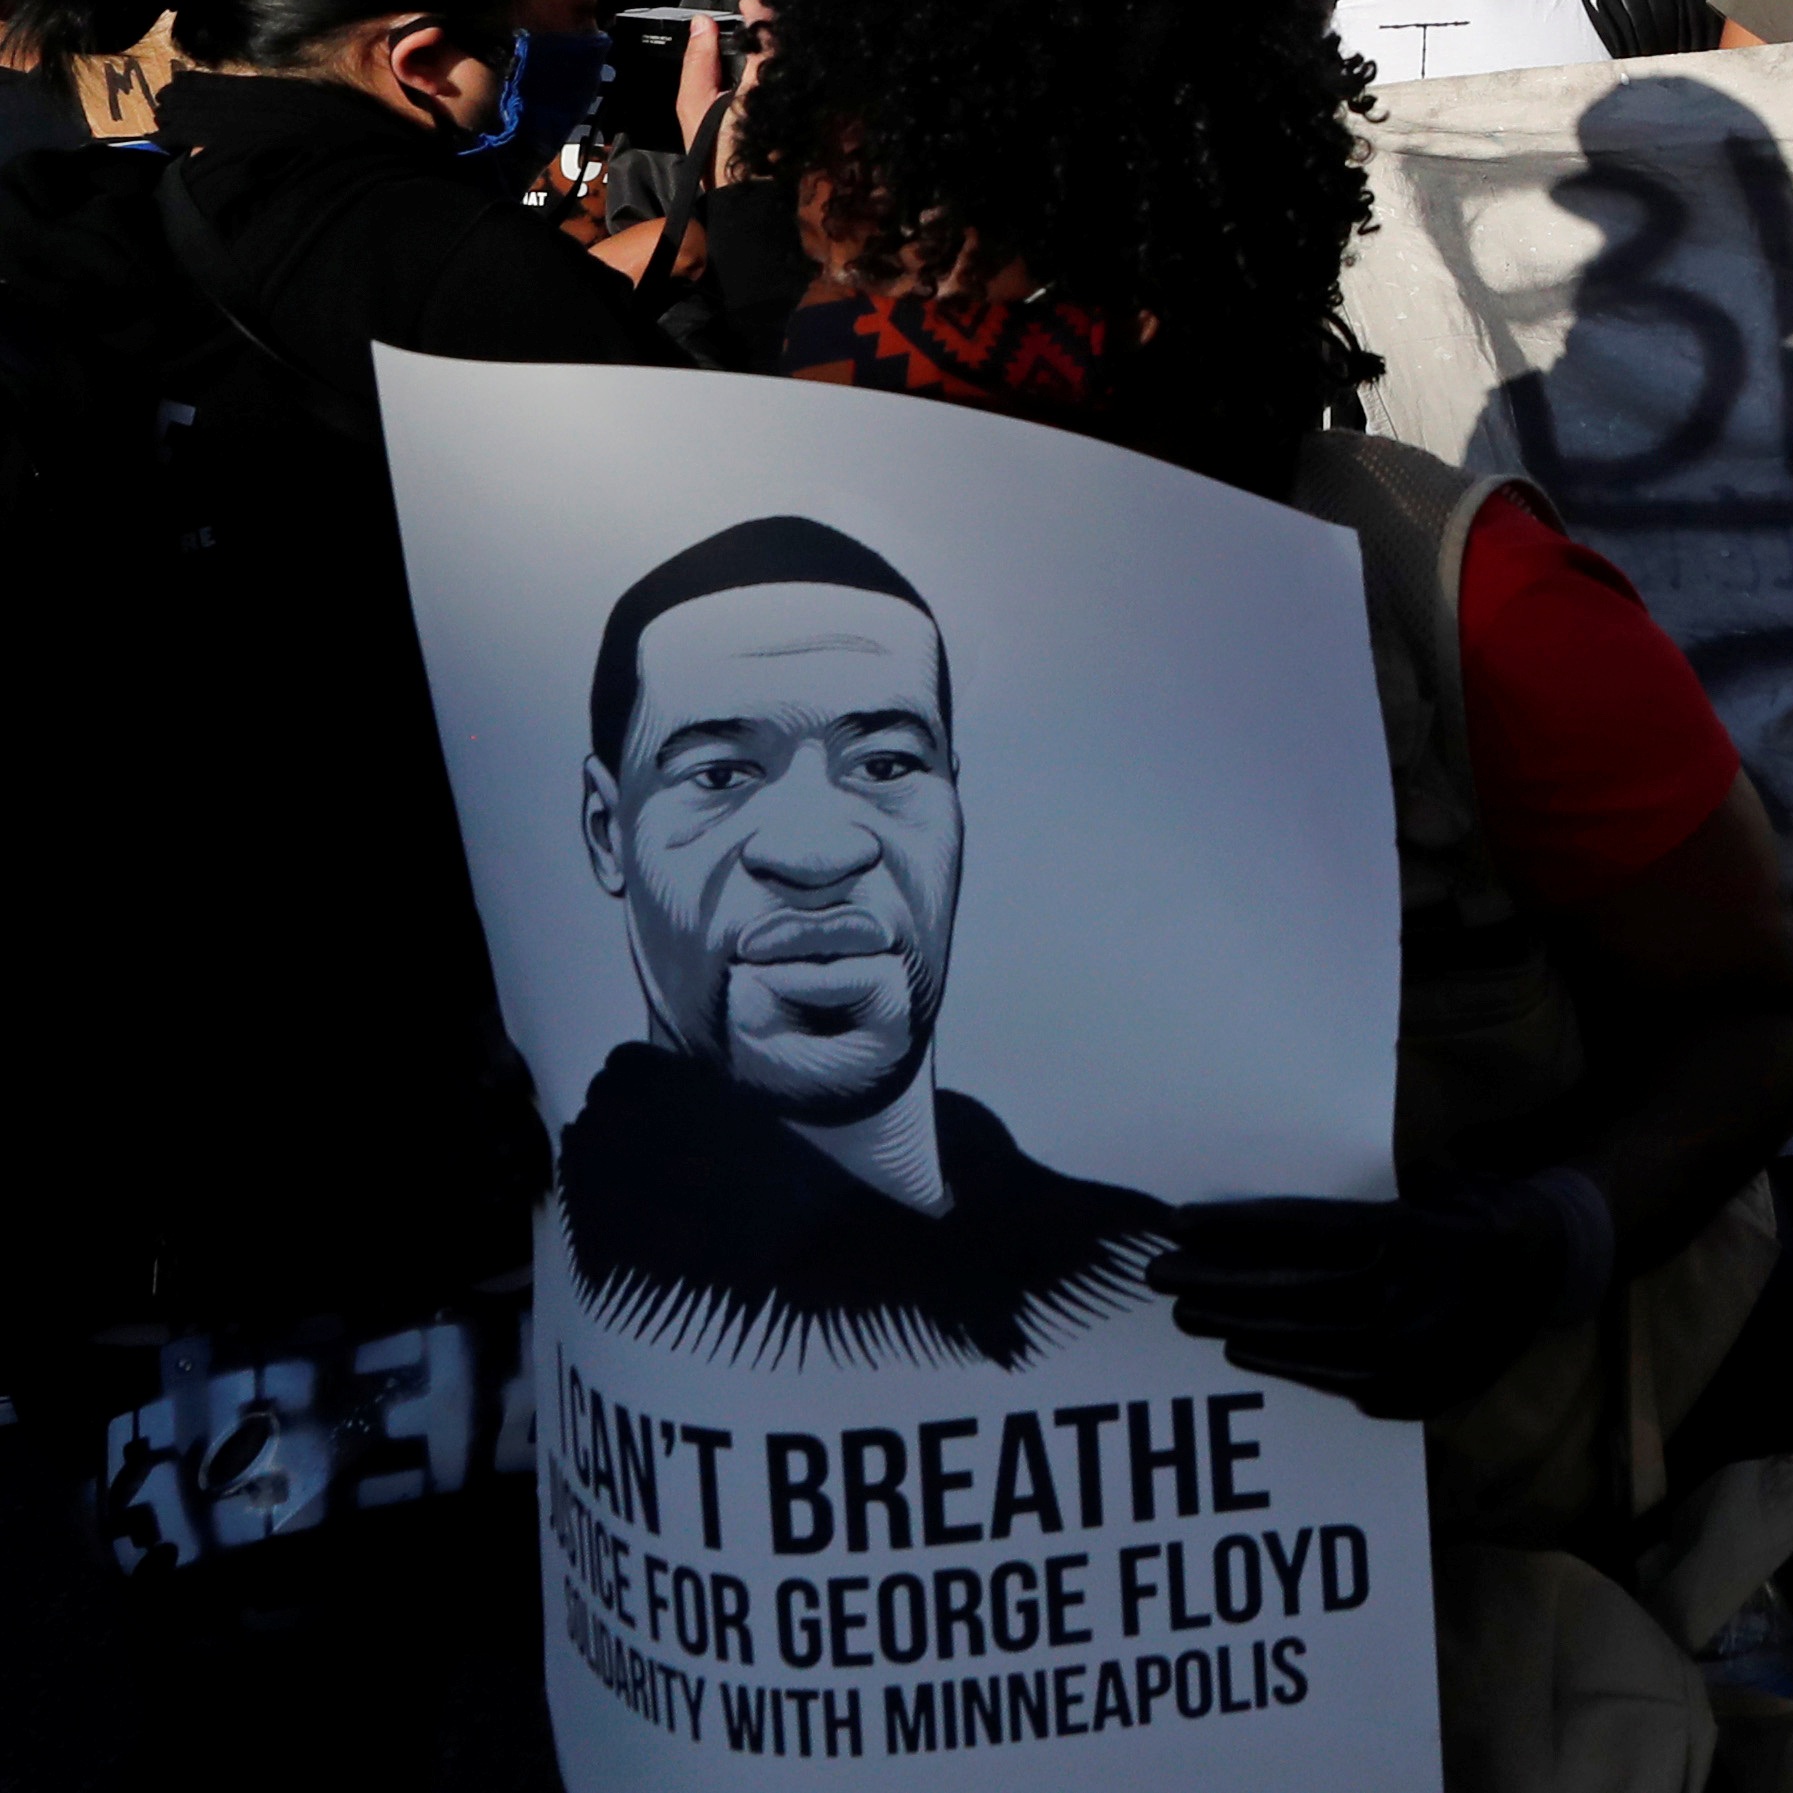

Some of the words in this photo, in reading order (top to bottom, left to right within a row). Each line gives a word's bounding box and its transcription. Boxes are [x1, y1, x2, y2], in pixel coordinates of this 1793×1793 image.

[555, 1341, 565, 1452] I
[573, 1369, 734, 1551] CAN'T
[764, 1390, 1271, 1558] BREATHE
[547, 1452, 634, 1630] JUSTICE
[644, 1549, 755, 1667] FOR
[774, 1551, 1093, 1670] GEORGE
[1117, 1523, 1372, 1640] FLOYD
[563, 1574, 706, 1744] SOLIDARITY
[719, 1679, 864, 1759] WITH
[884, 1635, 1310, 1757] MINNEAPOLIS
